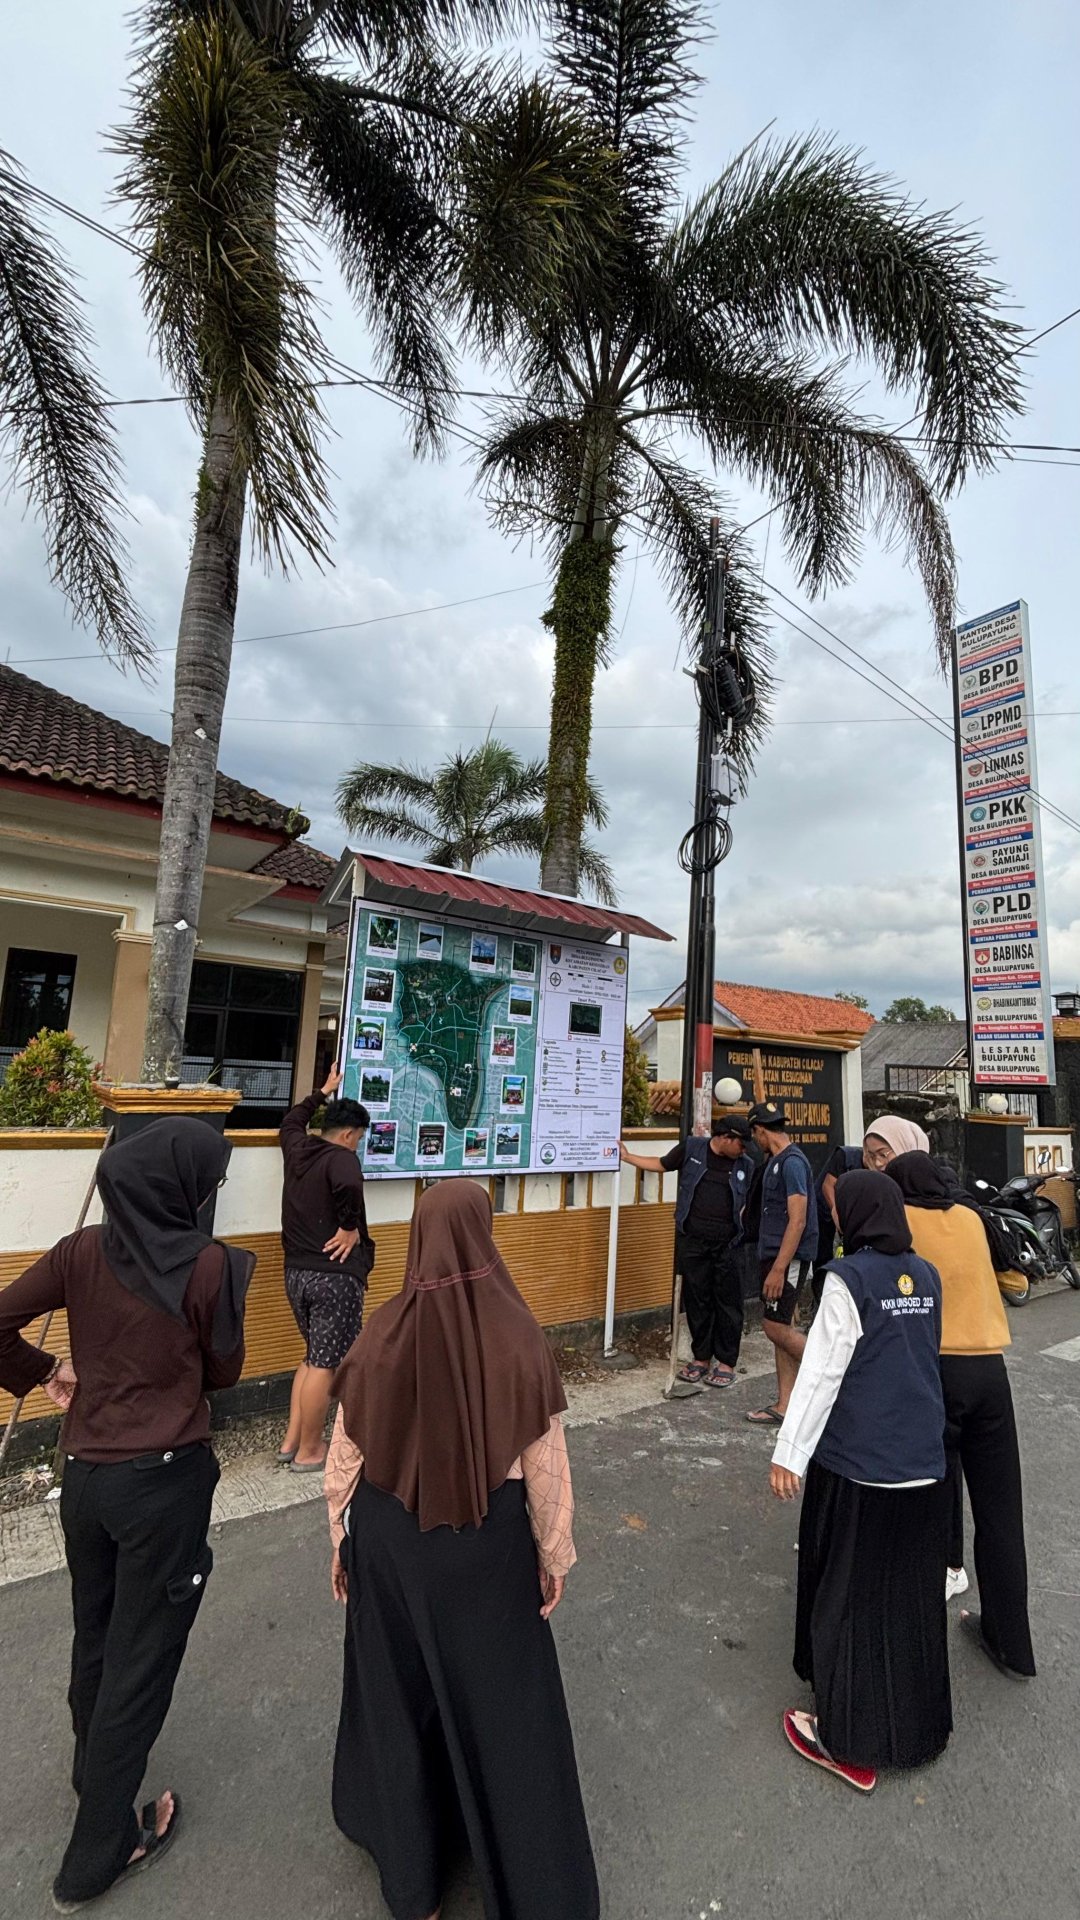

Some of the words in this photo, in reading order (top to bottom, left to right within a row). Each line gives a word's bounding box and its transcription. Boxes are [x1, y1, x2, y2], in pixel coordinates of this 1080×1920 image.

[960, 624, 992, 641] KANTOR
[995, 614, 1017, 629] DESA
[962, 622, 1016, 648] BULUPAYUNG
[979, 658, 1018, 686] BPD
[964, 690, 978, 700] DESA
[980, 677, 1019, 694] BULUPAYUNG
[981, 705, 1021, 730] LPPMD
[983, 722, 1022, 739] BULUPAYUNG
[984, 751, 1024, 773] LINMAS
[968, 780, 983, 788] DESA
[985, 769, 1025, 784] BULUPAYUNG
[989, 796, 1026, 820] PKK
[970, 825, 984, 833] DESA
[987, 815, 1027, 829] BULUPAYUNG
[975, 839, 997, 848] KARANG
[999, 835, 1022, 843] TARUNA
[992, 844, 1028, 857] PAYUNG
[992, 853, 1029, 866] SAMIAJI
[971, 871, 986, 879] DESA
[989, 864, 1030, 876] BULUPAYUNG
[993, 893, 1031, 914] PLD
[990, 913, 1032, 923] BULUPAYUNG
[992, 944, 1034, 961] BABINSA
[993, 963, 1035, 972] BULUPAYUNG
[768, 1055, 801, 1069] KABUPATEN
[802, 1058, 824, 1071] CILACAP
[782, 1070, 813, 1084] KESUGIHAN
[769, 1084, 803, 1098] BULUPAYUNG
[784, 1102, 830, 1126] BULUPAYUNG
[881, 1298, 896, 1310] KKN
[896, 1297, 920, 1308] UNSOED
